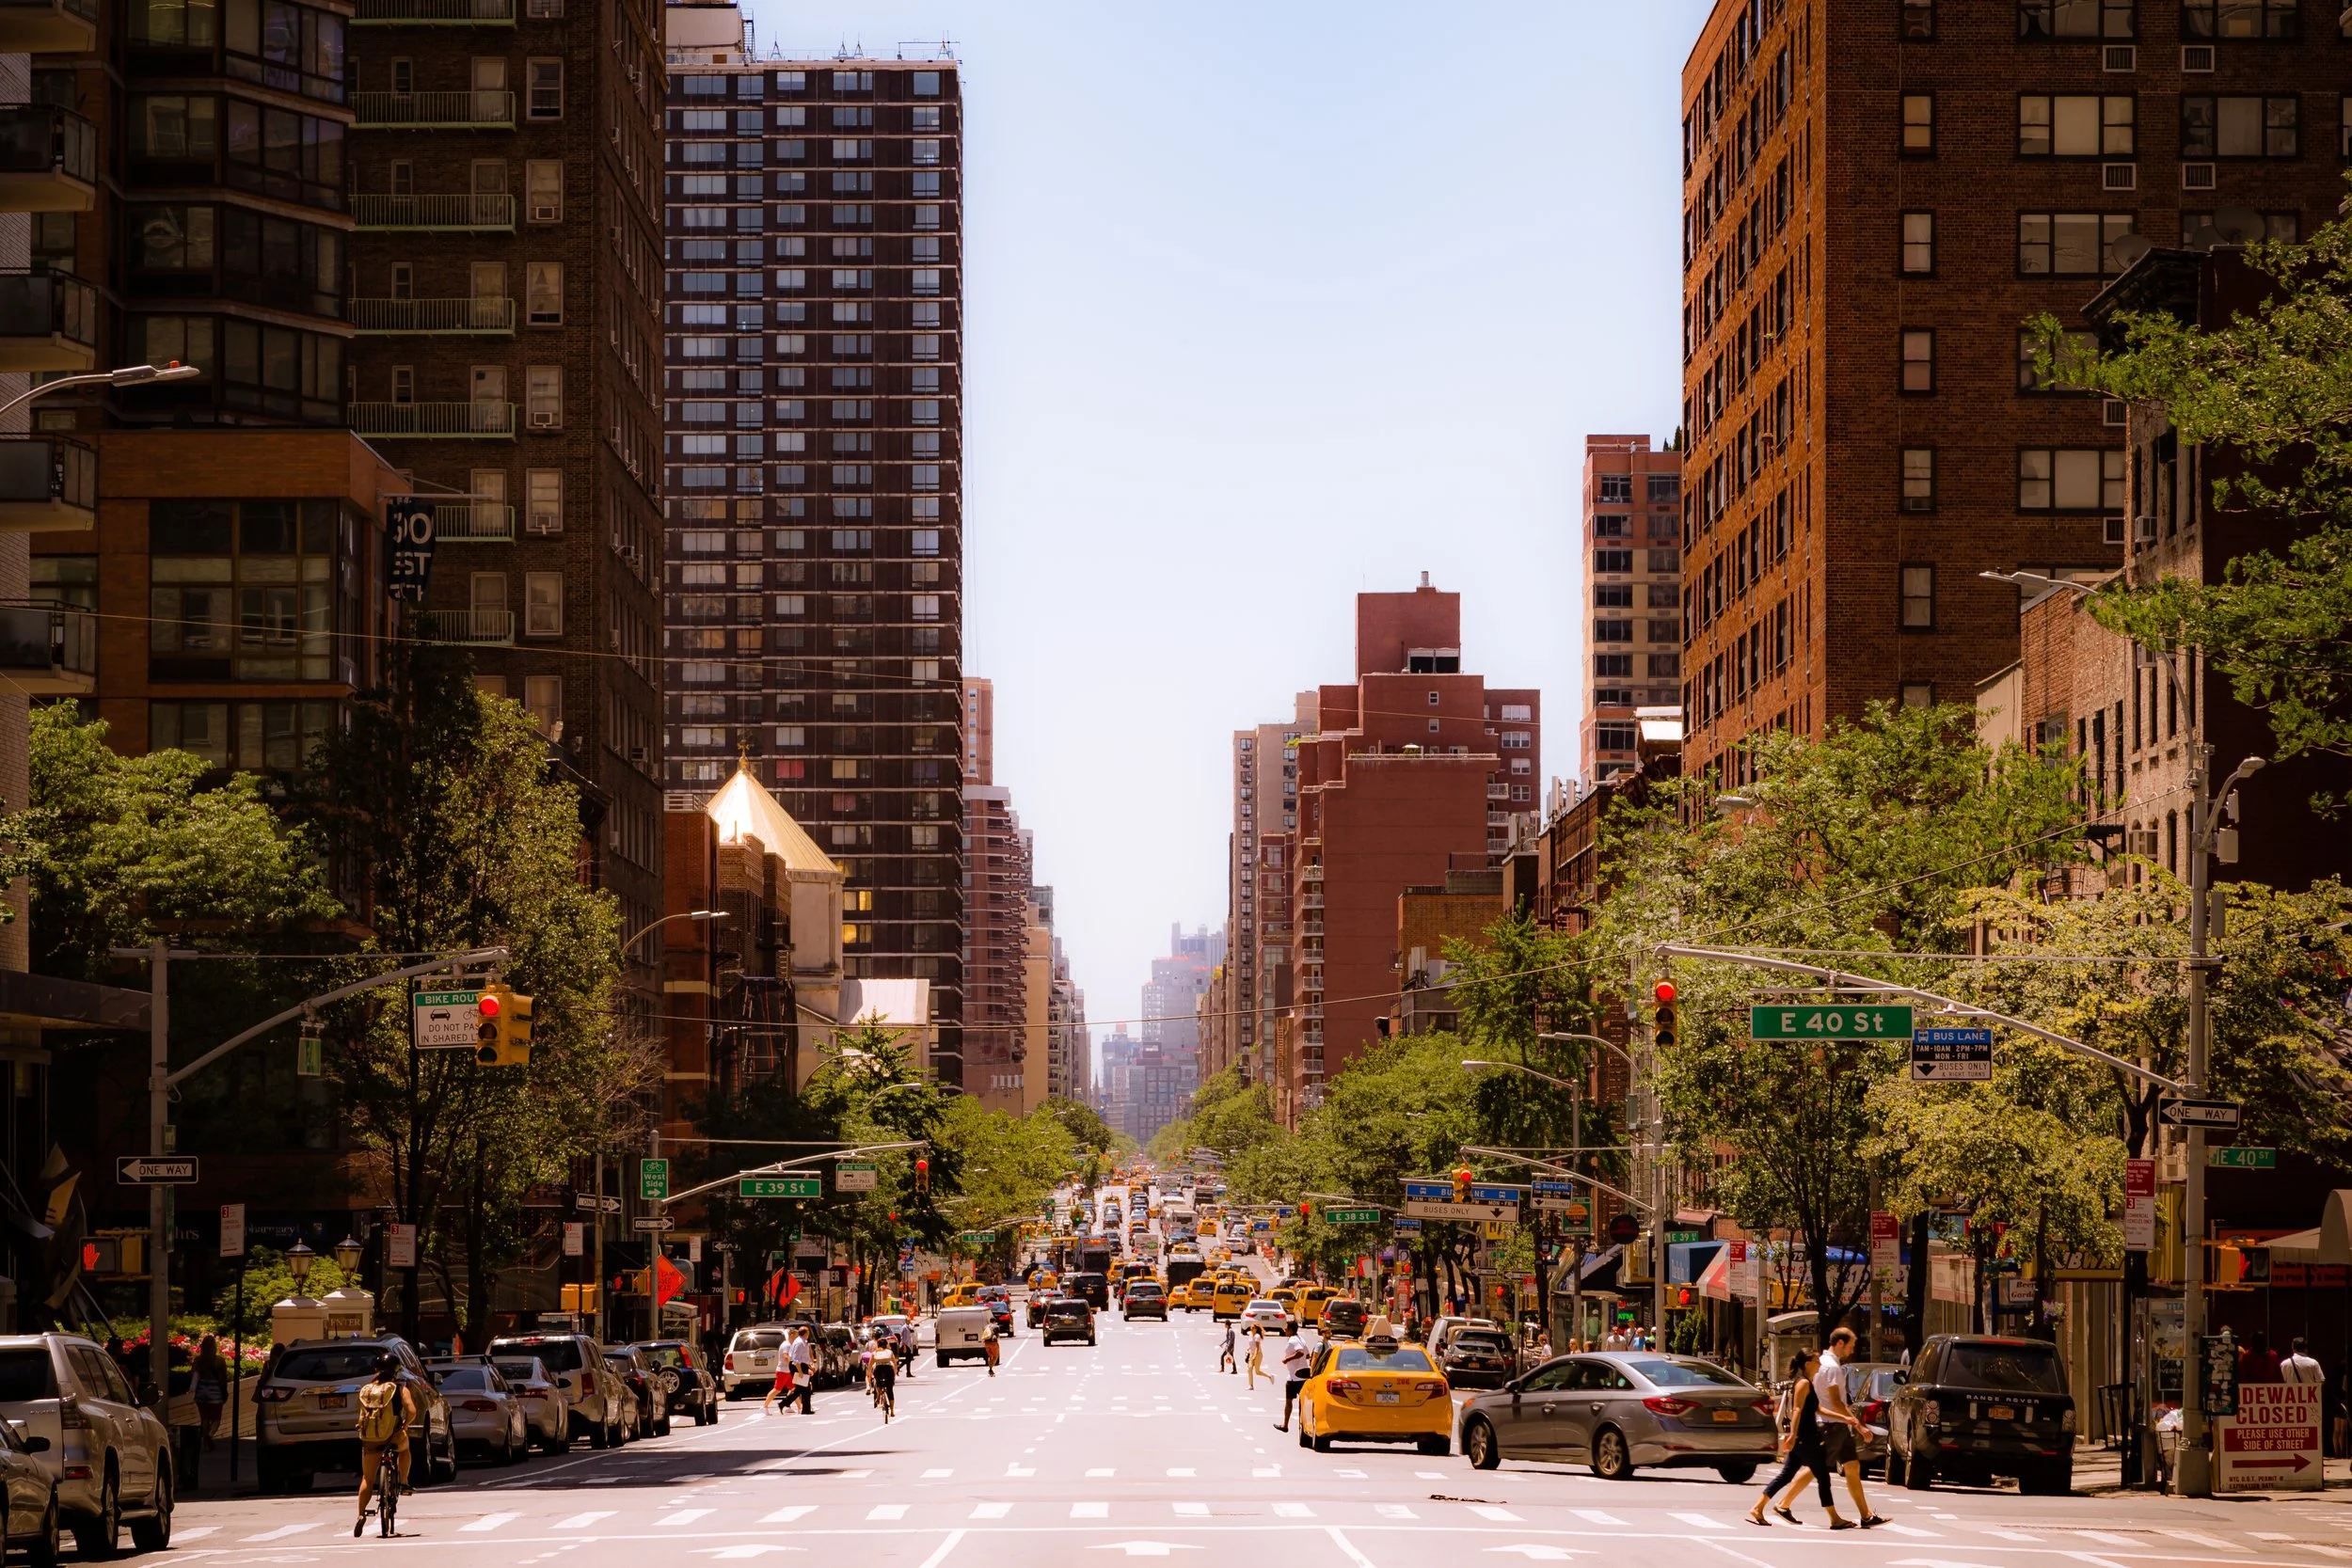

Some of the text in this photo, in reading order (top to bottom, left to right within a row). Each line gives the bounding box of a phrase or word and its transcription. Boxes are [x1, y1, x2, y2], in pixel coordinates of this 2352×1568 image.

[425, 992, 478, 1005] BIKE ROU
[1781, 1011, 1883, 1033] E 40 St
[429, 1024, 440, 1033] DO
[444, 1023, 460, 1032] NOT
[421, 1035, 430, 1043] IN
[433, 1034, 469, 1042] SHARED
[1933, 1032, 1986, 1041] BUS LANE
[2169, 1107, 2228, 1120] ONE WAY
[2220, 1150, 2270, 1165] E 40 ST
[139, 1165, 189, 1176] ONE WAY
[646, 1180, 664, 1188] Side
[755, 1182, 805, 1195] E 39 St
[1440, 1188, 1453, 1196] BU
[2128, 1197, 2134, 1209] 3
[1423, 1206, 1448, 1214] BUSES
[1336, 1212, 1371, 1221] E 38 St
[175, 1227, 199, 1241] hrs
[245, 1224, 296, 1238] pharmacy
[392, 1226, 398, 1235] 3
[1672, 1232, 1678, 1242] E
[1679, 1232, 1691, 1242] 39
[1874, 1241, 1881, 1249] 3
[2166, 1302, 2184, 1310] TITA
[1617, 1312, 1634, 1321] ATM
[330, 1318, 361, 1326] ENTER
[2236, 1405, 2307, 1425] CLOSED
[2237, 1428, 2310, 1439] PLEASE USE OTHER
[2243, 1439, 2304, 1450] SIDE OF STREET
